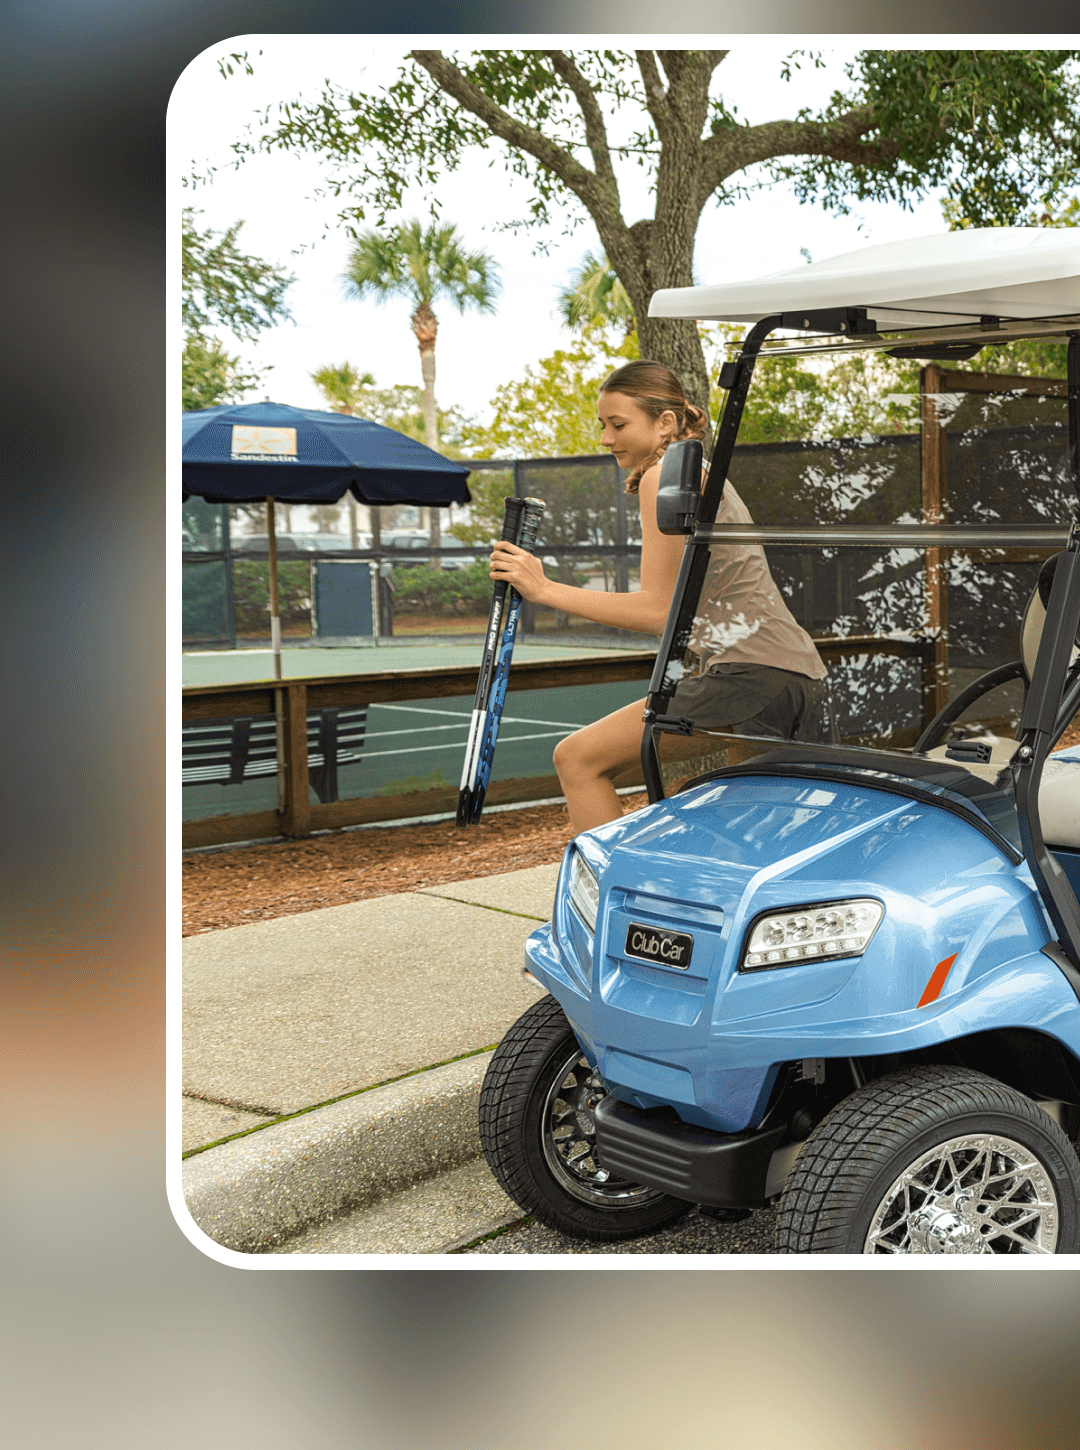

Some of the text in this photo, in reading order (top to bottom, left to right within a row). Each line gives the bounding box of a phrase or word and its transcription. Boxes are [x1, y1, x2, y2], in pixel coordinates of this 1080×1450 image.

[230, 452, 300, 463] Sandestin
[487, 600, 501, 651] PRO STAFF
[506, 609, 518, 636] ULTRA
[631, 931, 685, 961] Club Car
[1043, 1144, 1067, 1176] RADIAL
